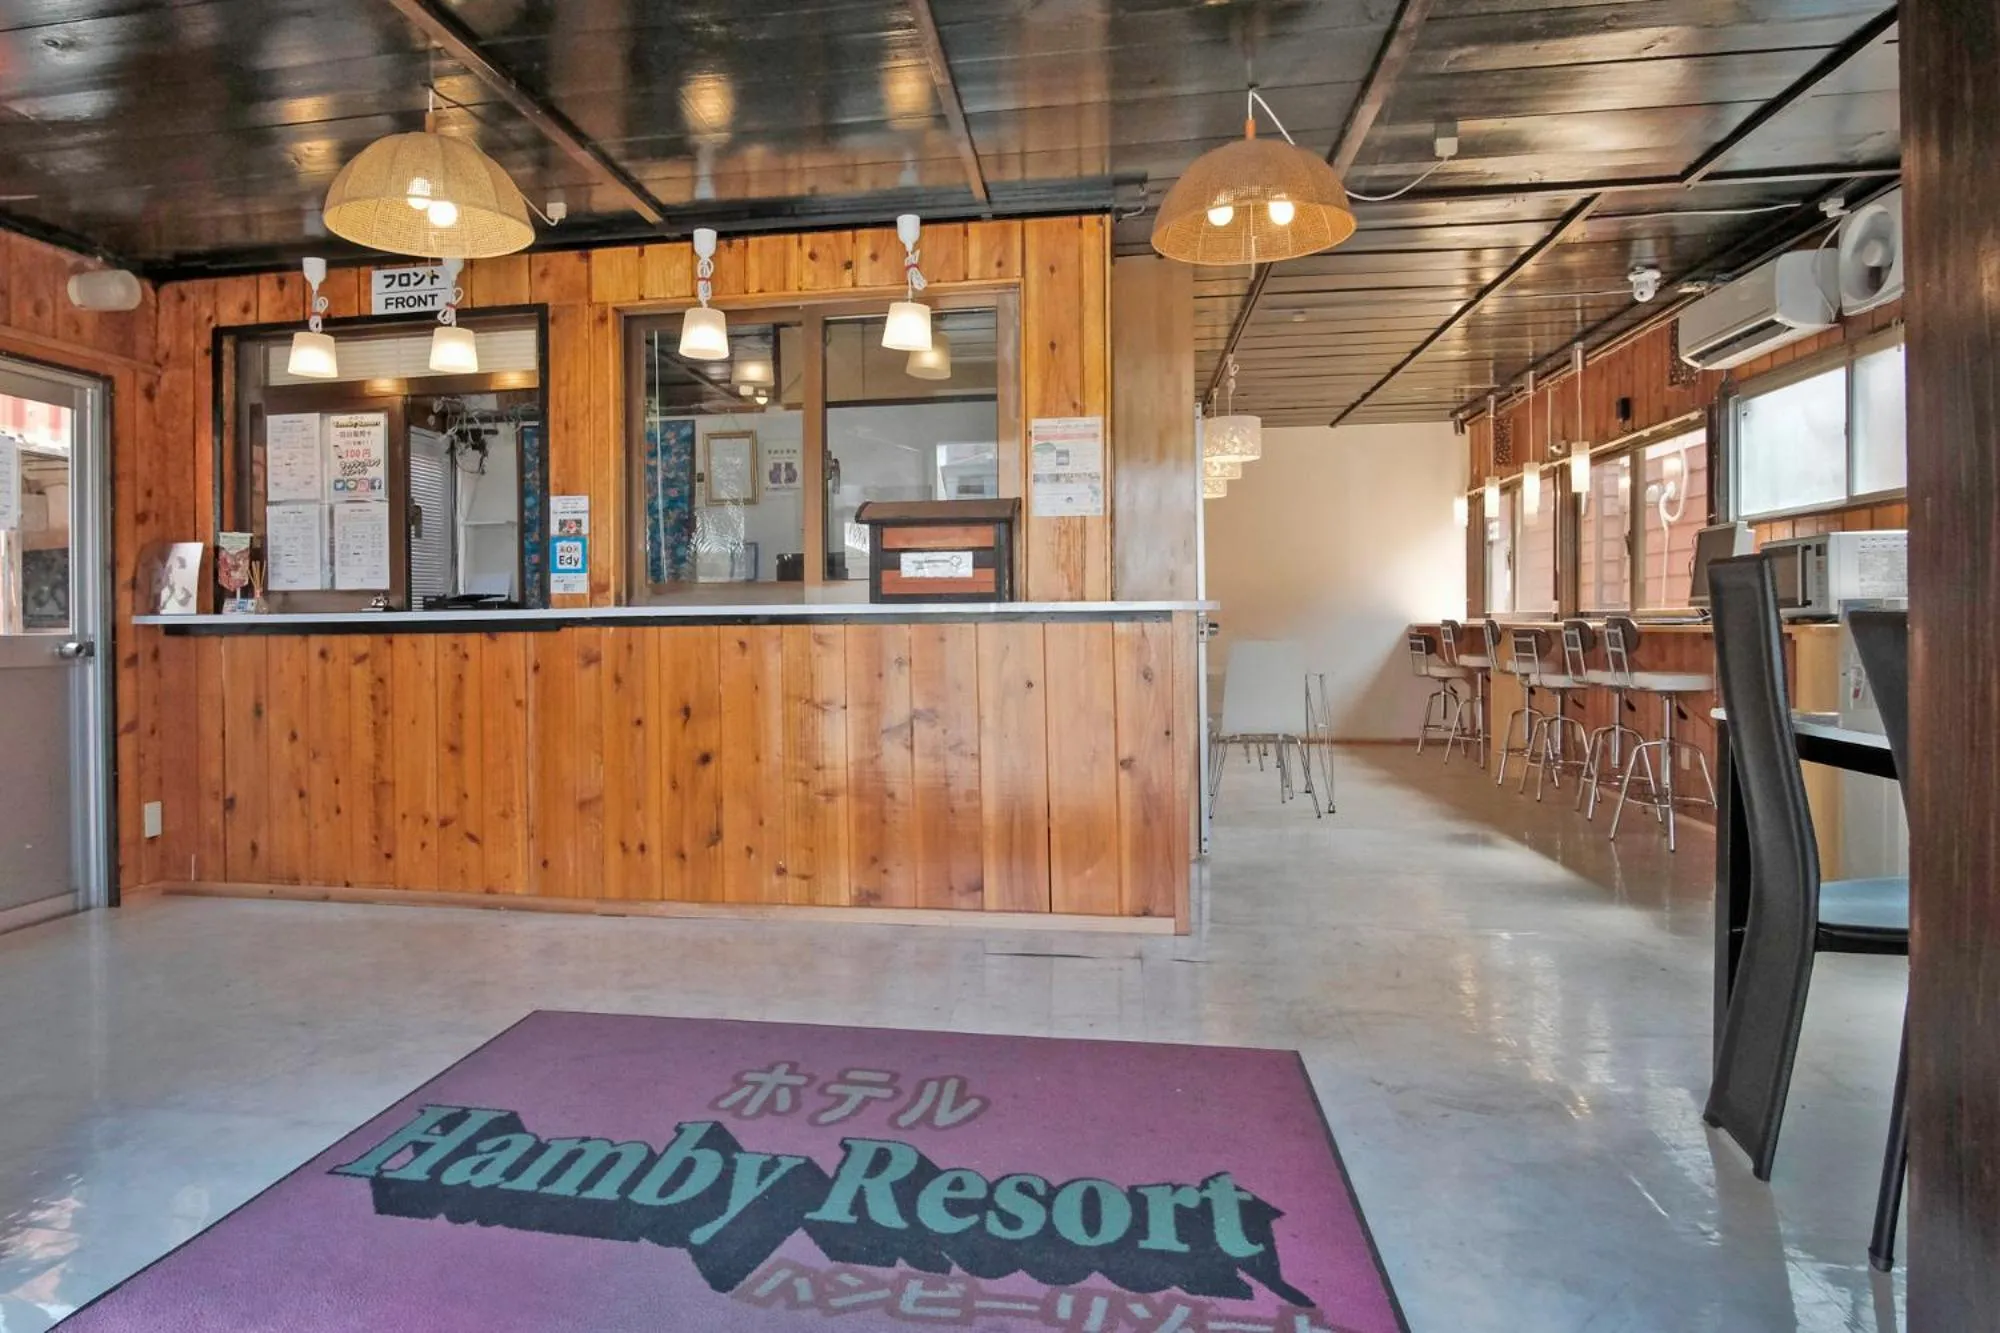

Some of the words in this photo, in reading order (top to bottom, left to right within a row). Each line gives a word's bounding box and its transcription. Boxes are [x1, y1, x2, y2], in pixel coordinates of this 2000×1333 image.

[383, 269, 440, 288] フロント
[384, 293, 438, 310] FRONT
[559, 555, 579, 567] Edy
[709, 1061, 989, 1128] ホテル
[327, 1104, 805, 1250] Hamby
[803, 1136, 1268, 1262] Resort
